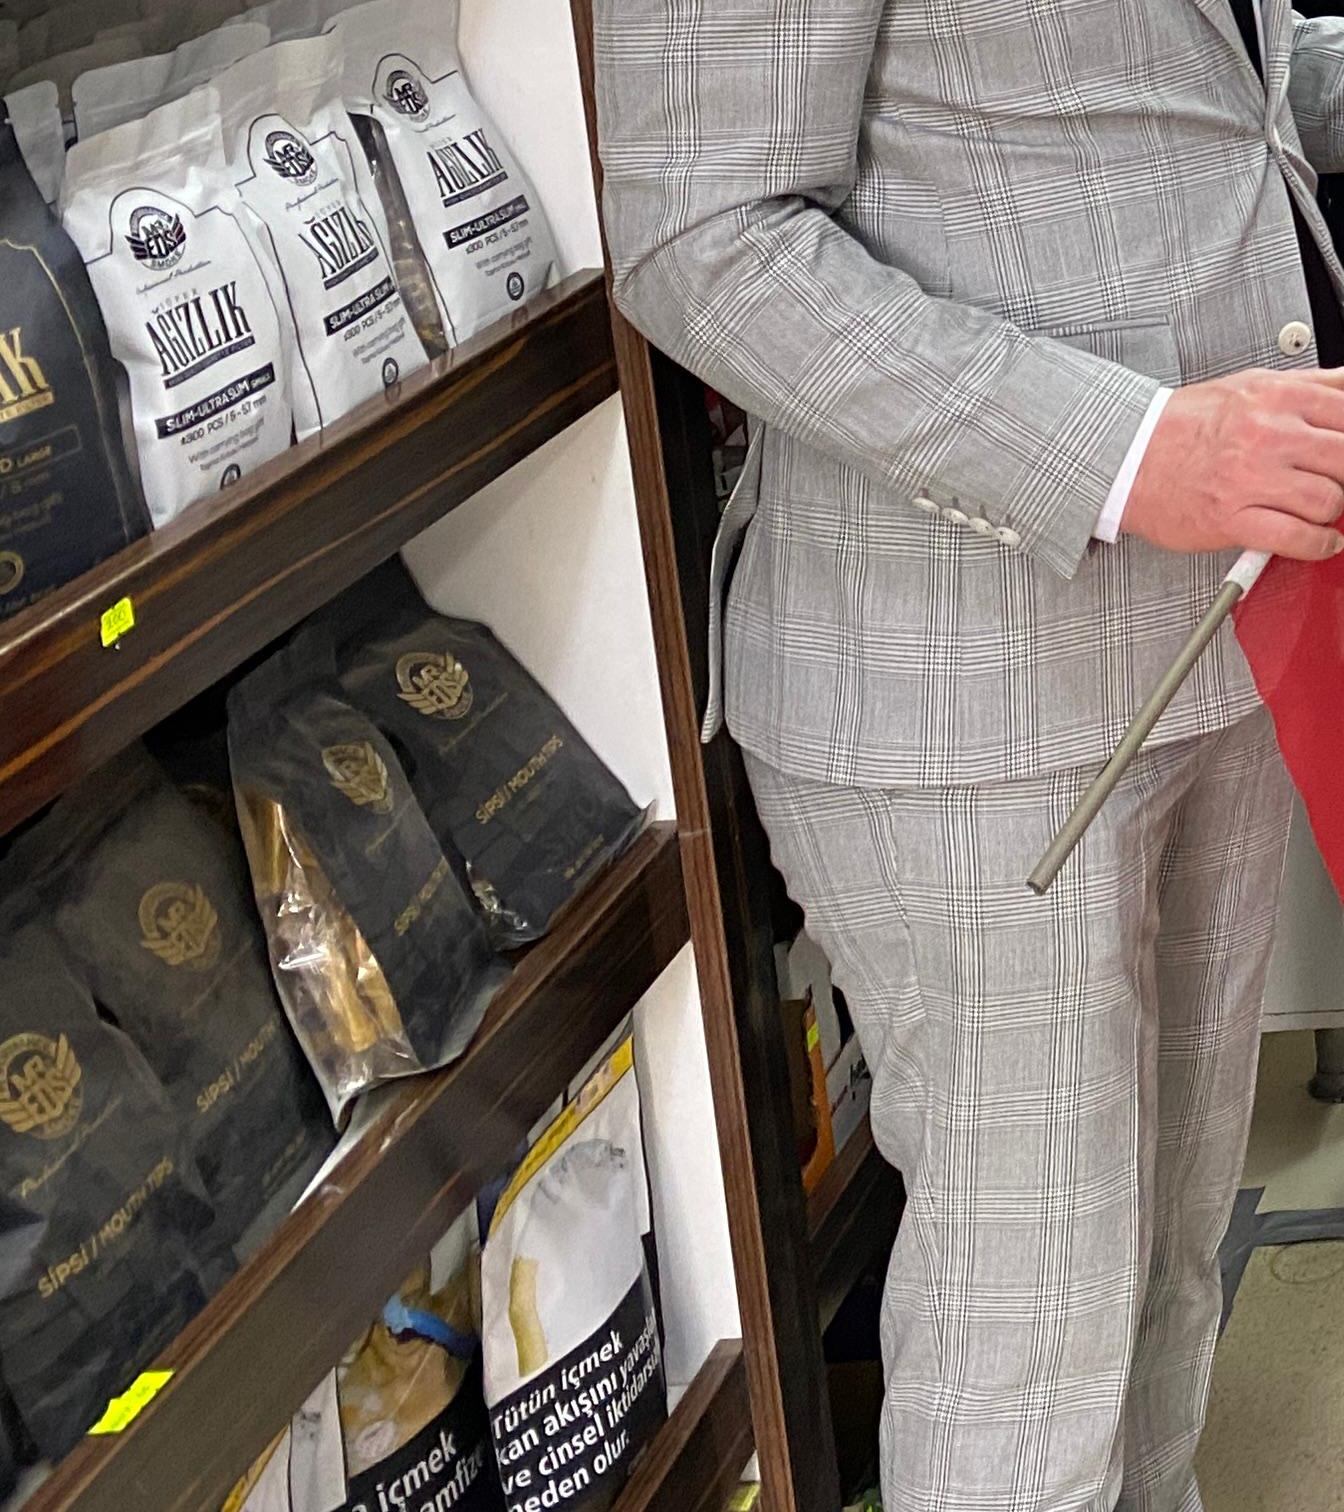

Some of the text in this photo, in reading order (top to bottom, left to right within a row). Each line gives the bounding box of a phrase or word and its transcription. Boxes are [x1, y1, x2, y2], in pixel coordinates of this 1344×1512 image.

[146, 230, 177, 258] EDS
[207, 419, 224, 436] PCS
[508, 755, 547, 792] MOUTH
[38, 1243, 89, 1298] SİPSİ
[99, 1188, 148, 1247] MOUTH
[146, 1155, 174, 1191] TIPS
[491, 1331, 624, 1439] Tütün içmek
[498, 1375, 619, 1466] kan akışını
[376, 1431, 457, 1512] içmek
[503, 1410, 606, 1495] ve cinsel
[593, 1426, 631, 1476] olur.
